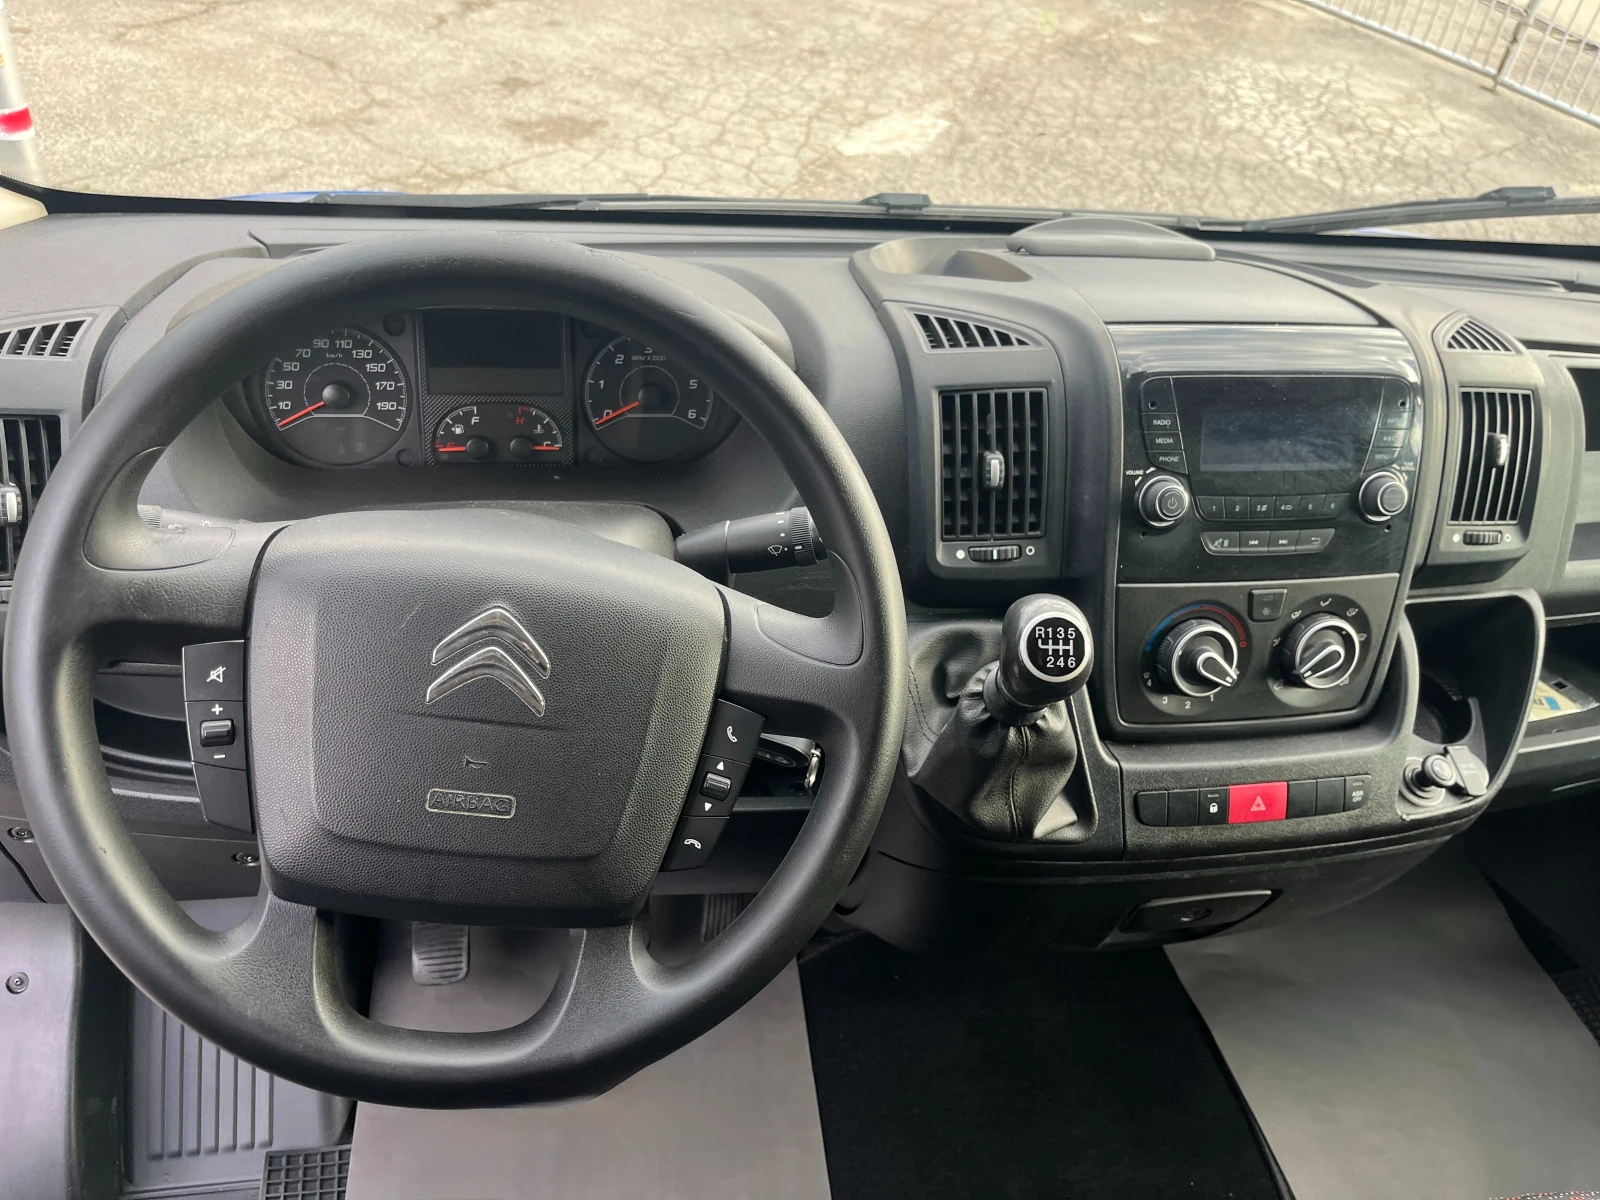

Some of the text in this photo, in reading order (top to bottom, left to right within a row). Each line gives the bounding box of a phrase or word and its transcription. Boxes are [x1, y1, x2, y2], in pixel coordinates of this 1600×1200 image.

[312, 339, 329, 348] 90
[335, 340, 352, 348] 110
[296, 349, 311, 358] 70
[351, 350, 372, 359] 130
[615, 354, 624, 365] 2
[283, 362, 299, 371] 50
[366, 363, 386, 372] 150
[276, 380, 292, 390] 30
[375, 381, 395, 390] 170
[599, 380, 604, 389] 1
[689, 379, 698, 389] 5
[278, 401, 291, 410] 10
[376, 402, 397, 411] 190
[688, 410, 697, 419] 6
[471, 416, 480, 425] F
[516, 416, 525, 425] H
[1162, 696, 1168, 704] 3
[1209, 694, 1214, 702] 1
[1184, 701, 1191, 709] 2
[430, 792, 510, 812] AIRBAG
